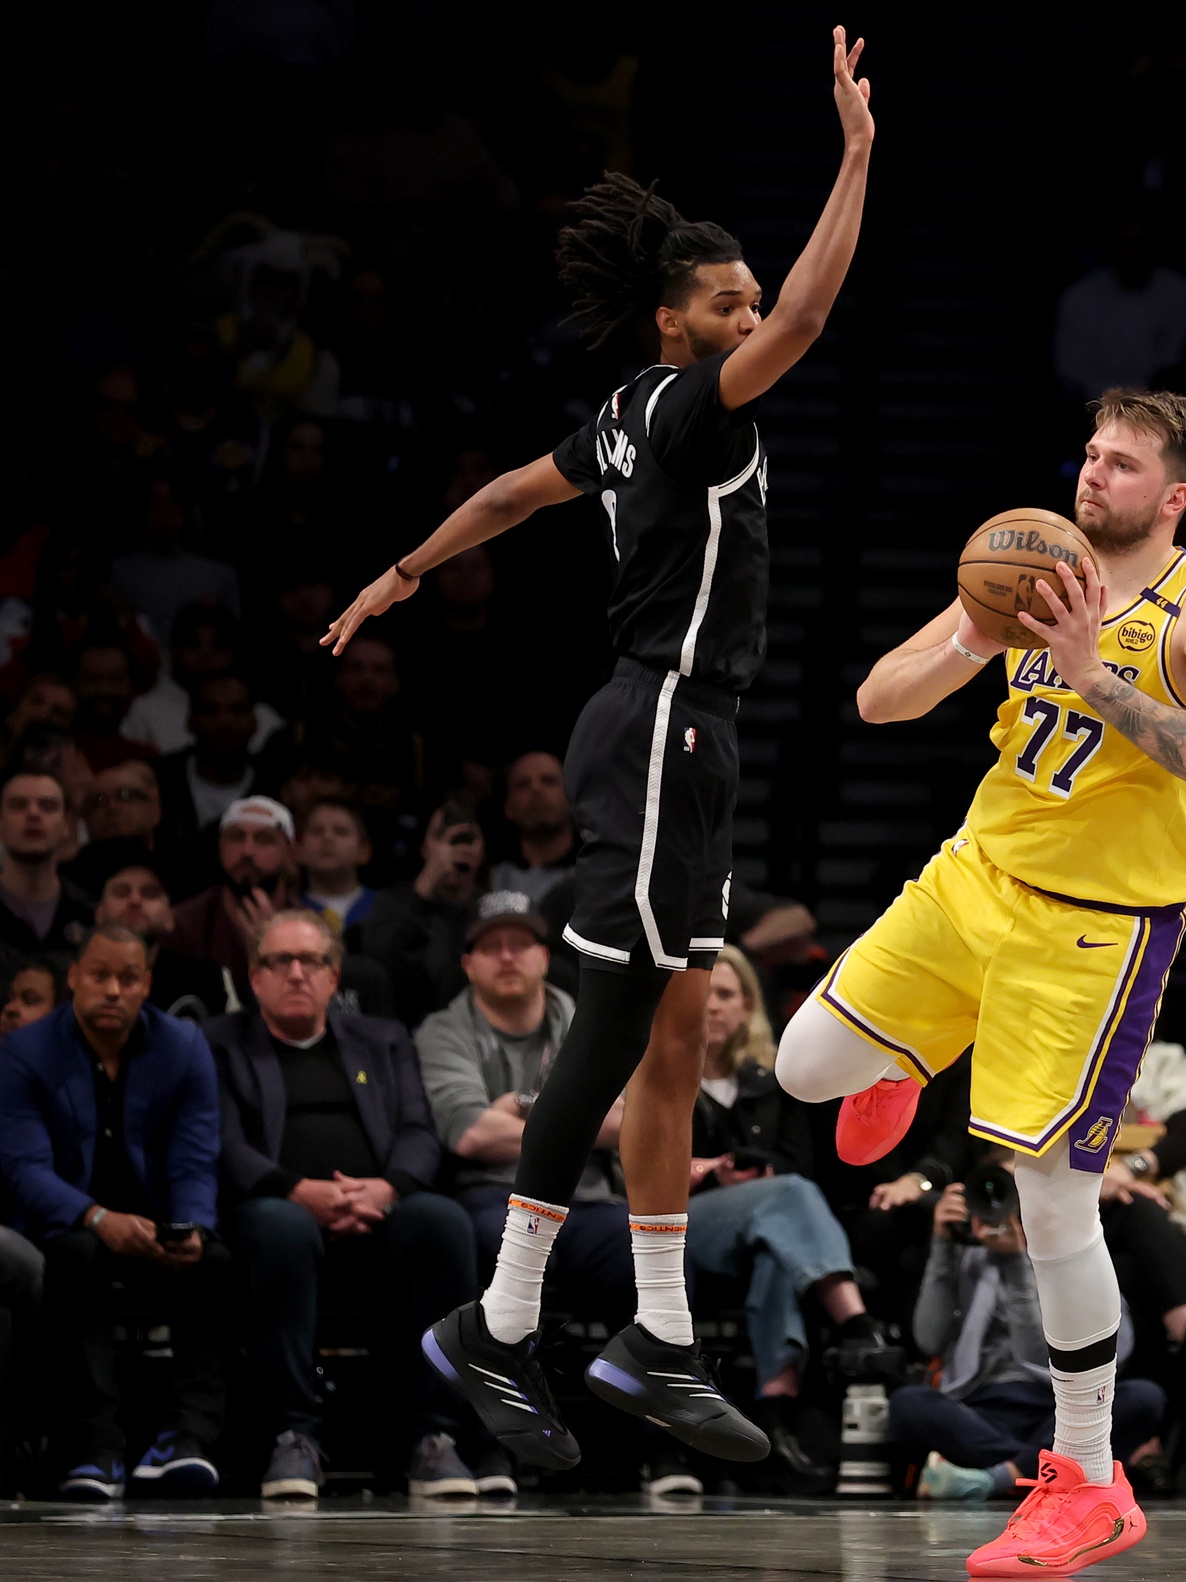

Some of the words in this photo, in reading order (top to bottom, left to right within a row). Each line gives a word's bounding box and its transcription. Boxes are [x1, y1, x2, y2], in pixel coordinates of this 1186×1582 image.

[989, 530, 1078, 568] Wilson
[1156, 598, 1168, 608] 44
[1122, 627, 1153, 643] bibigo
[1015, 696, 1106, 800] 77
